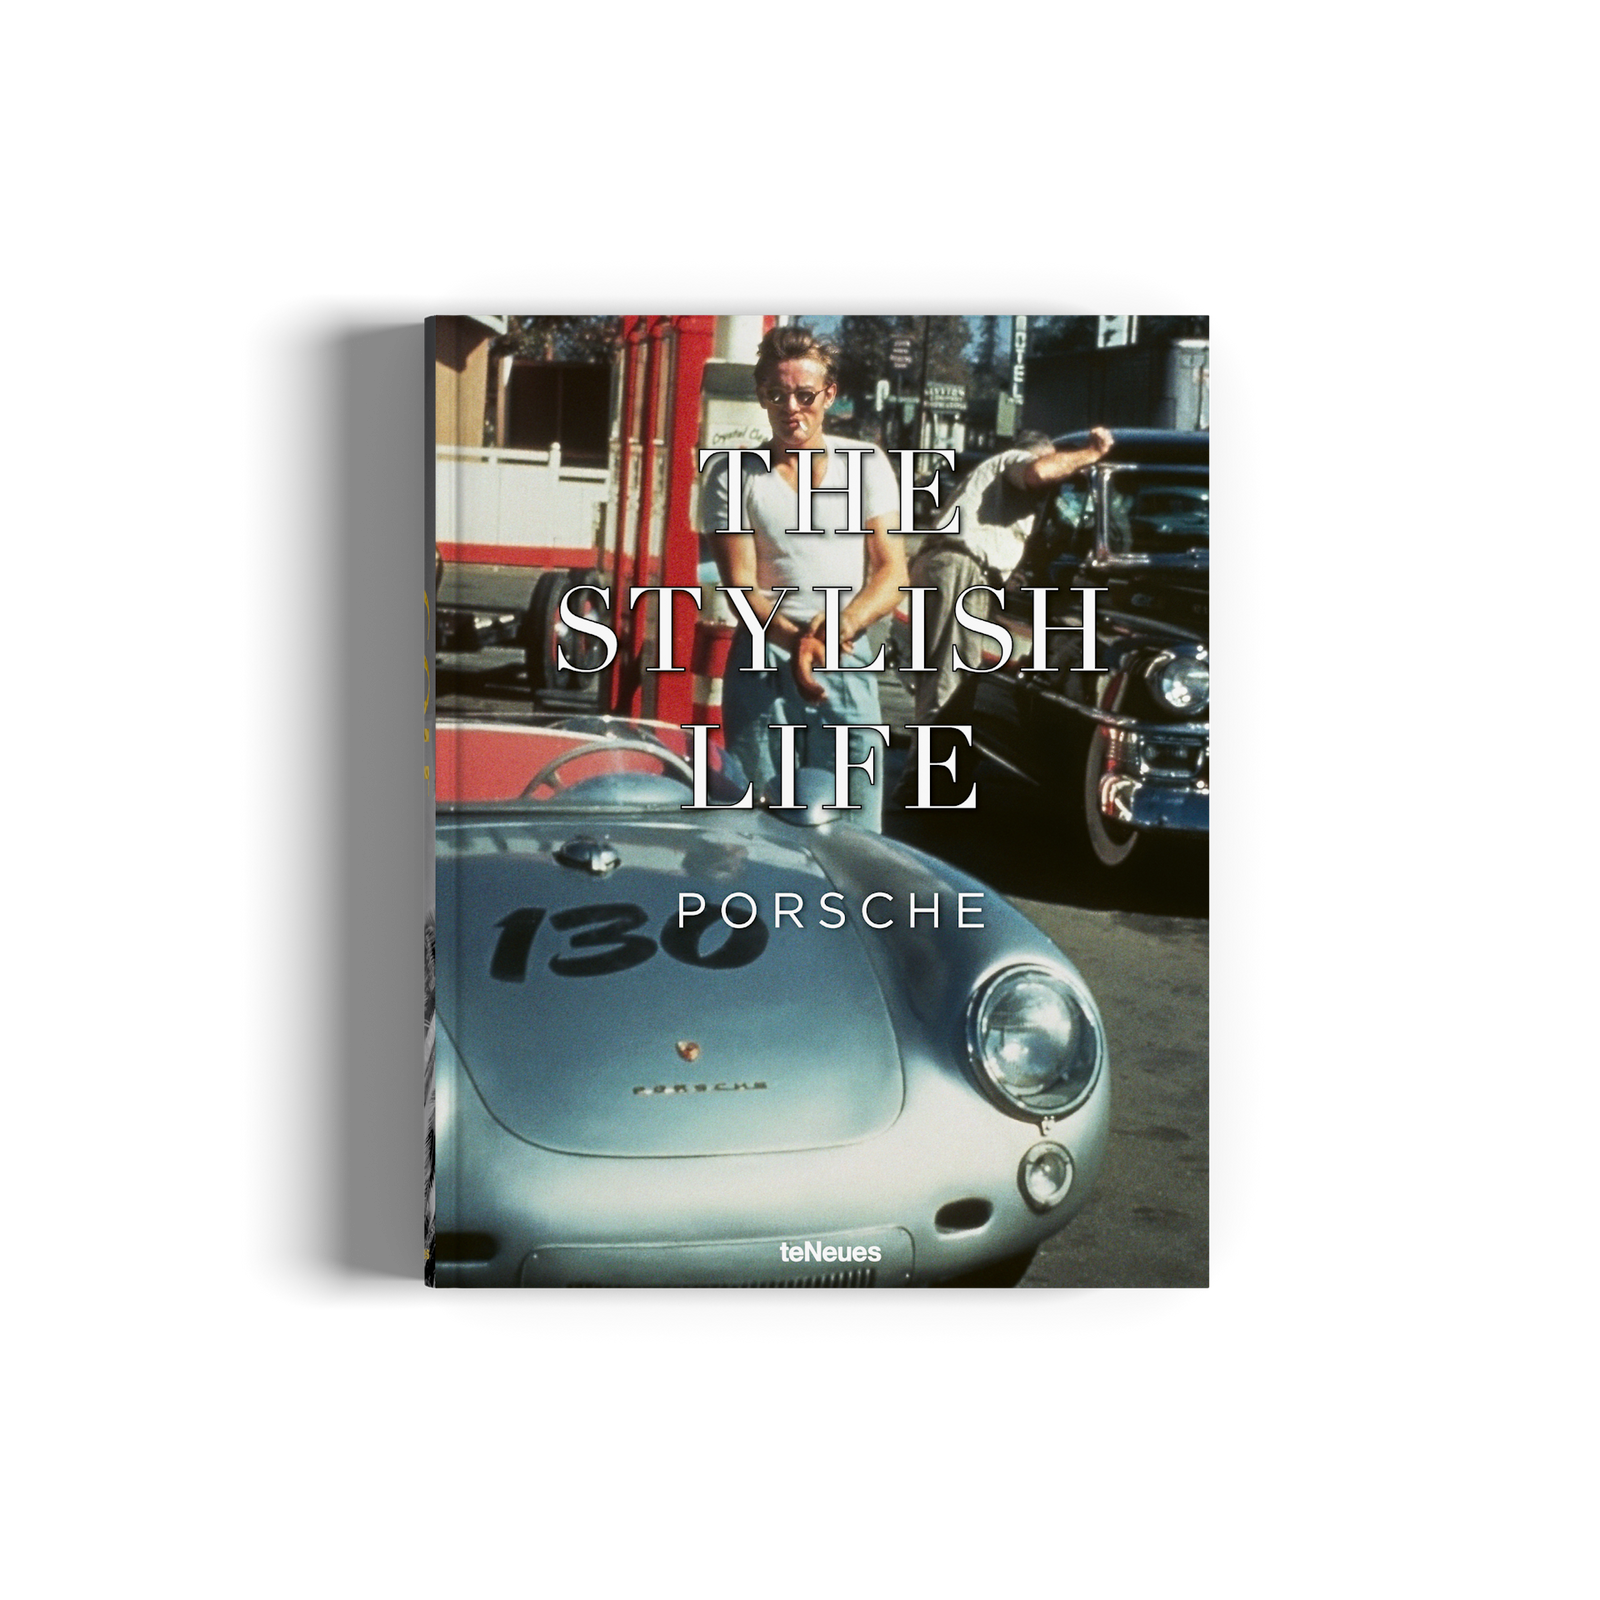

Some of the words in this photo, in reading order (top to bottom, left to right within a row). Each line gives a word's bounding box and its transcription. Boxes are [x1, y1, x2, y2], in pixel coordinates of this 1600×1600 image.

[699, 448, 962, 535] THE
[556, 584, 1109, 674] STYLISH
[680, 723, 978, 811] LIFE
[490, 902, 769, 984] 130
[679, 892, 986, 930] PORSCHE
[632, 1081, 767, 1096] PORSCHE
[779, 1241, 882, 1263] teNeues
